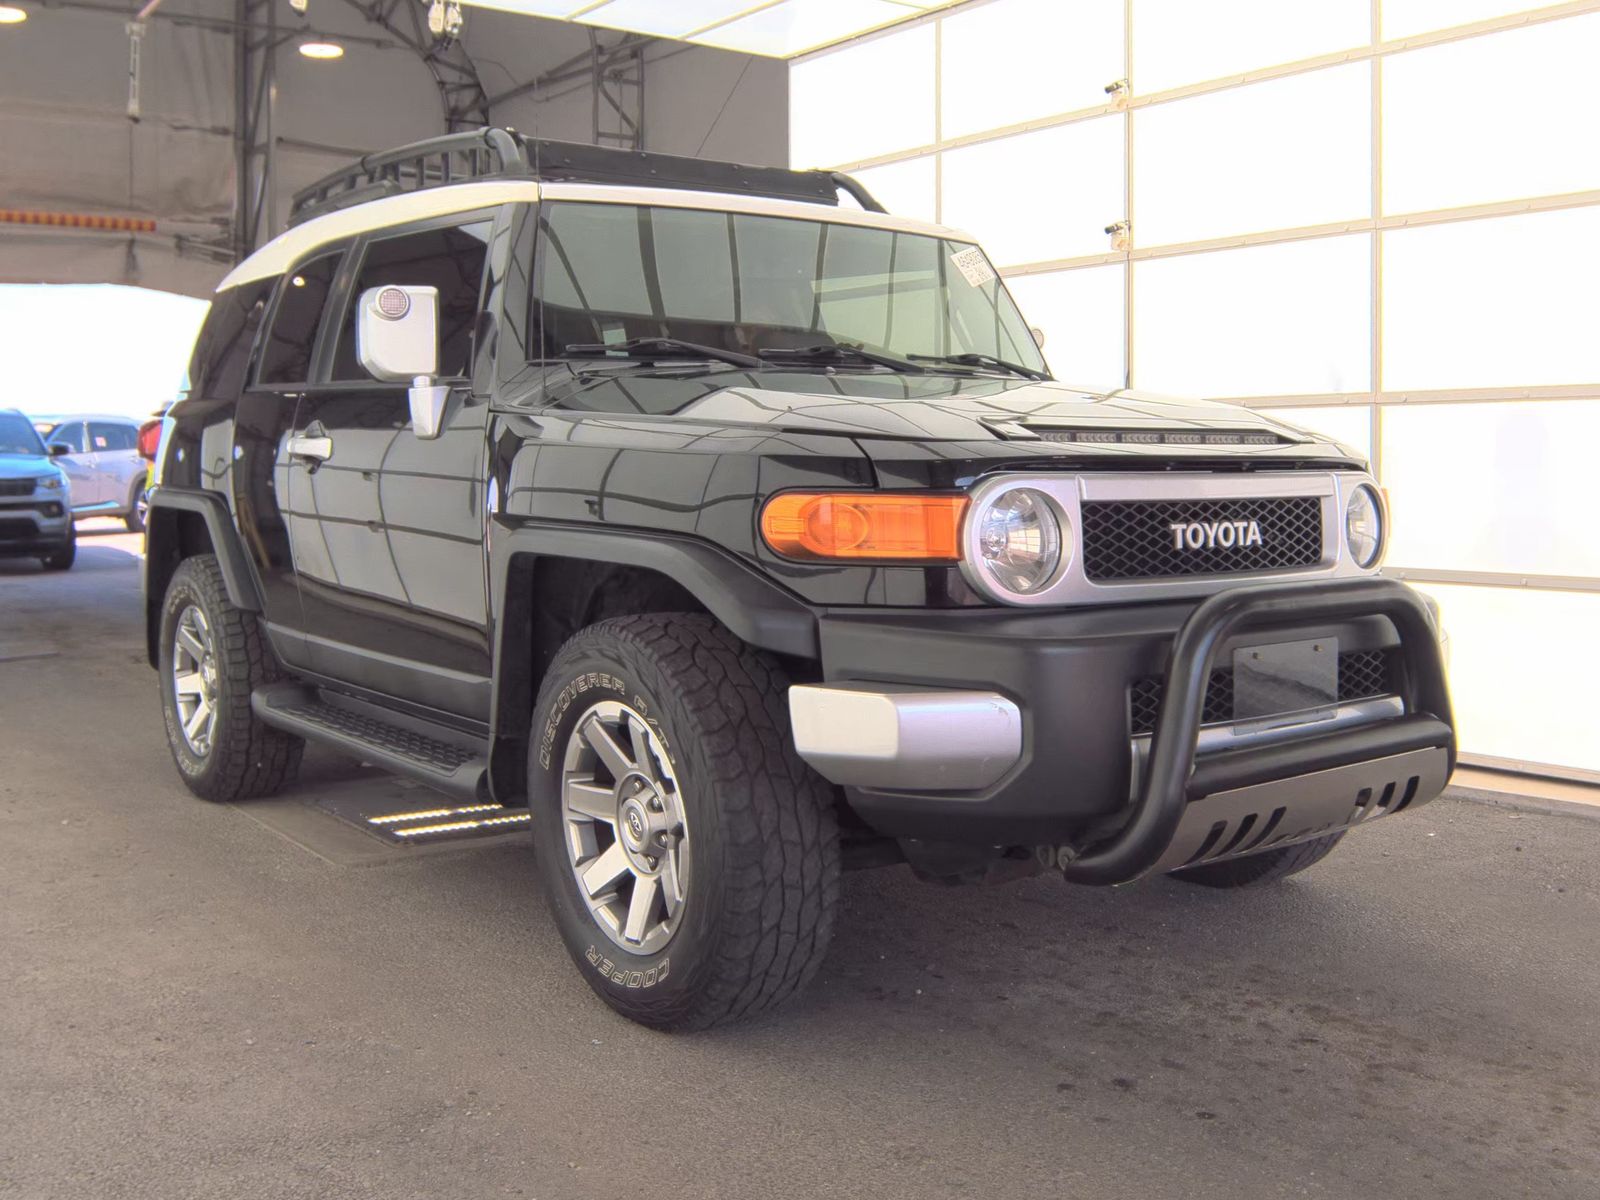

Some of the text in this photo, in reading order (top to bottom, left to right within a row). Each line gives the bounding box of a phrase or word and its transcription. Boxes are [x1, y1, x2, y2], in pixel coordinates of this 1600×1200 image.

[1170, 520, 1262, 549] TOYOTA
[538, 672, 625, 771] DISCOVERER
[585, 945, 670, 988] COOPER
